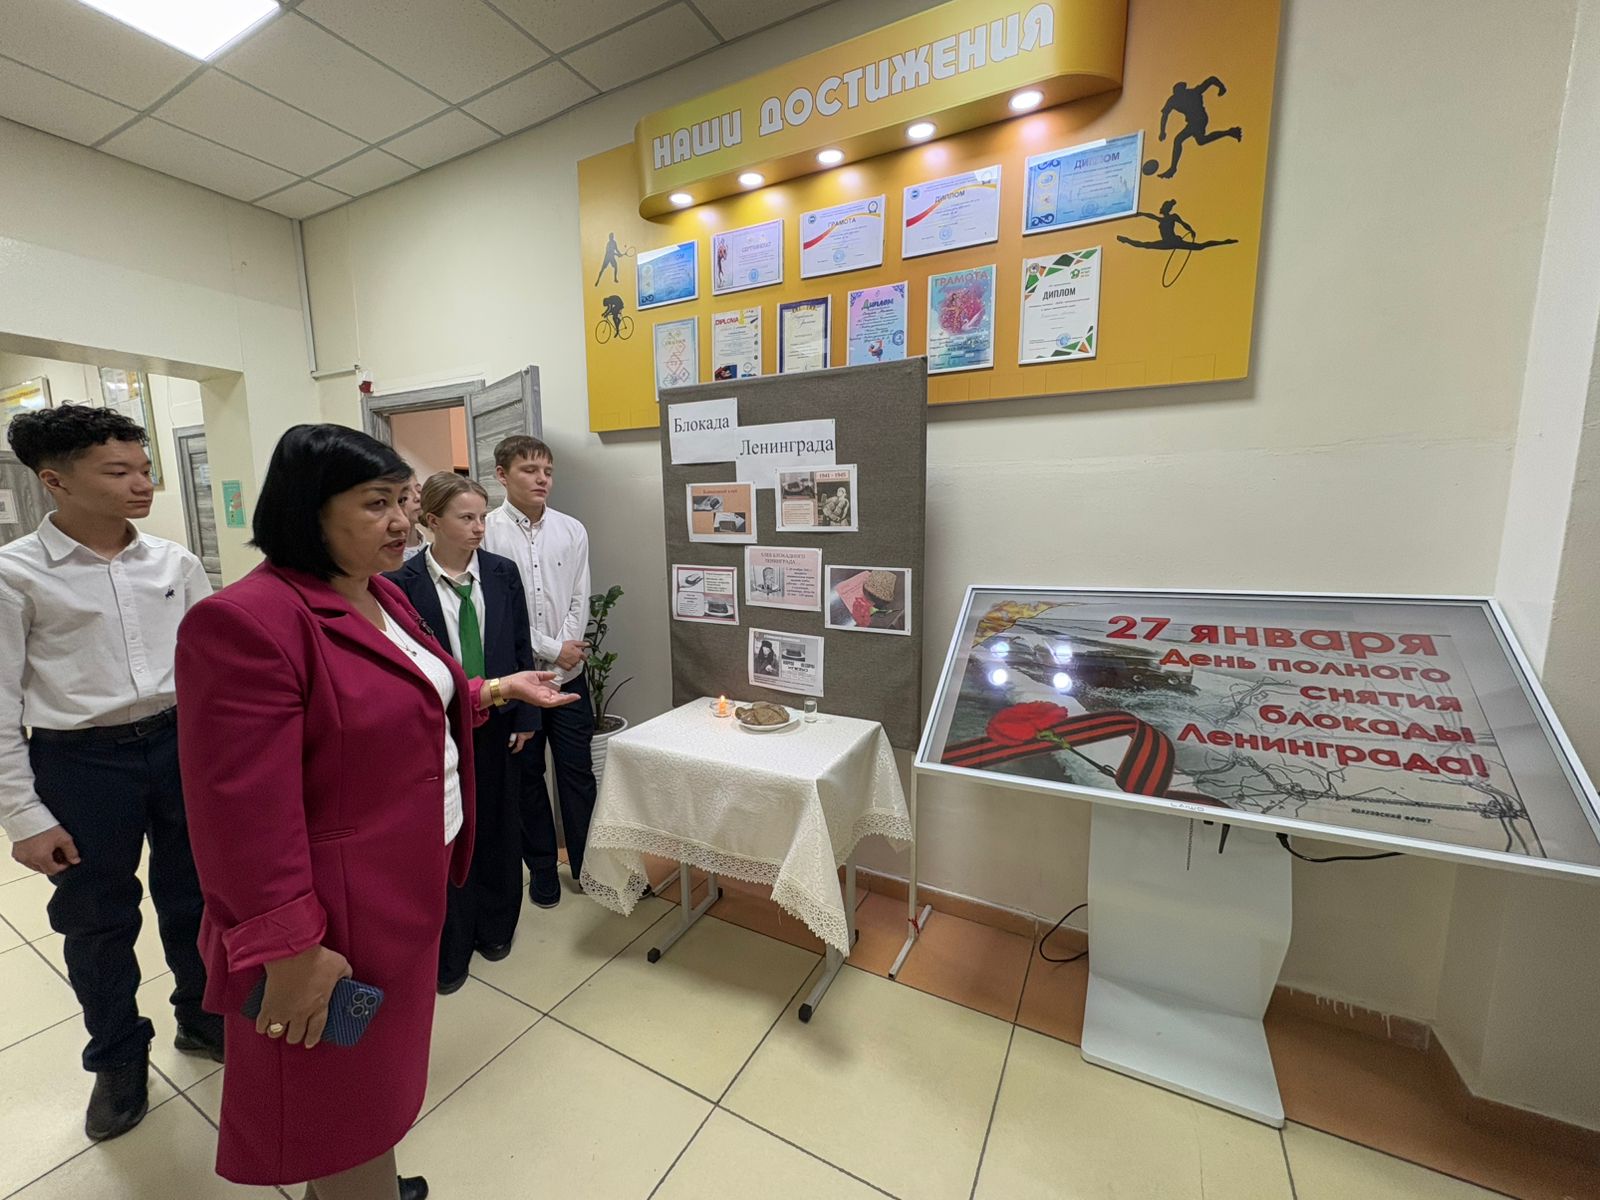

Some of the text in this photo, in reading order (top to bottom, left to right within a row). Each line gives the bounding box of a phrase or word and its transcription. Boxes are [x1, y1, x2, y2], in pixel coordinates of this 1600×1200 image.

[651, 3, 1055, 171] НАШИ ДОСТИЖЕНИЯ
[934, 271, 989, 287] ГРАМОТА
[1042, 287, 1076, 301] ДИПЛОМ
[714, 317, 738, 326] DIPLOMA
[674, 416, 730, 433] Блокада
[740, 438, 834, 457] Ленинграда
[1106, 615, 1438, 660] 27 января
[1159, 648, 1451, 683] День полного
[1299, 686, 1463, 712] снятия
[1258, 704, 1476, 744] блокады
[1177, 723, 1490, 778] Ленинграда!
